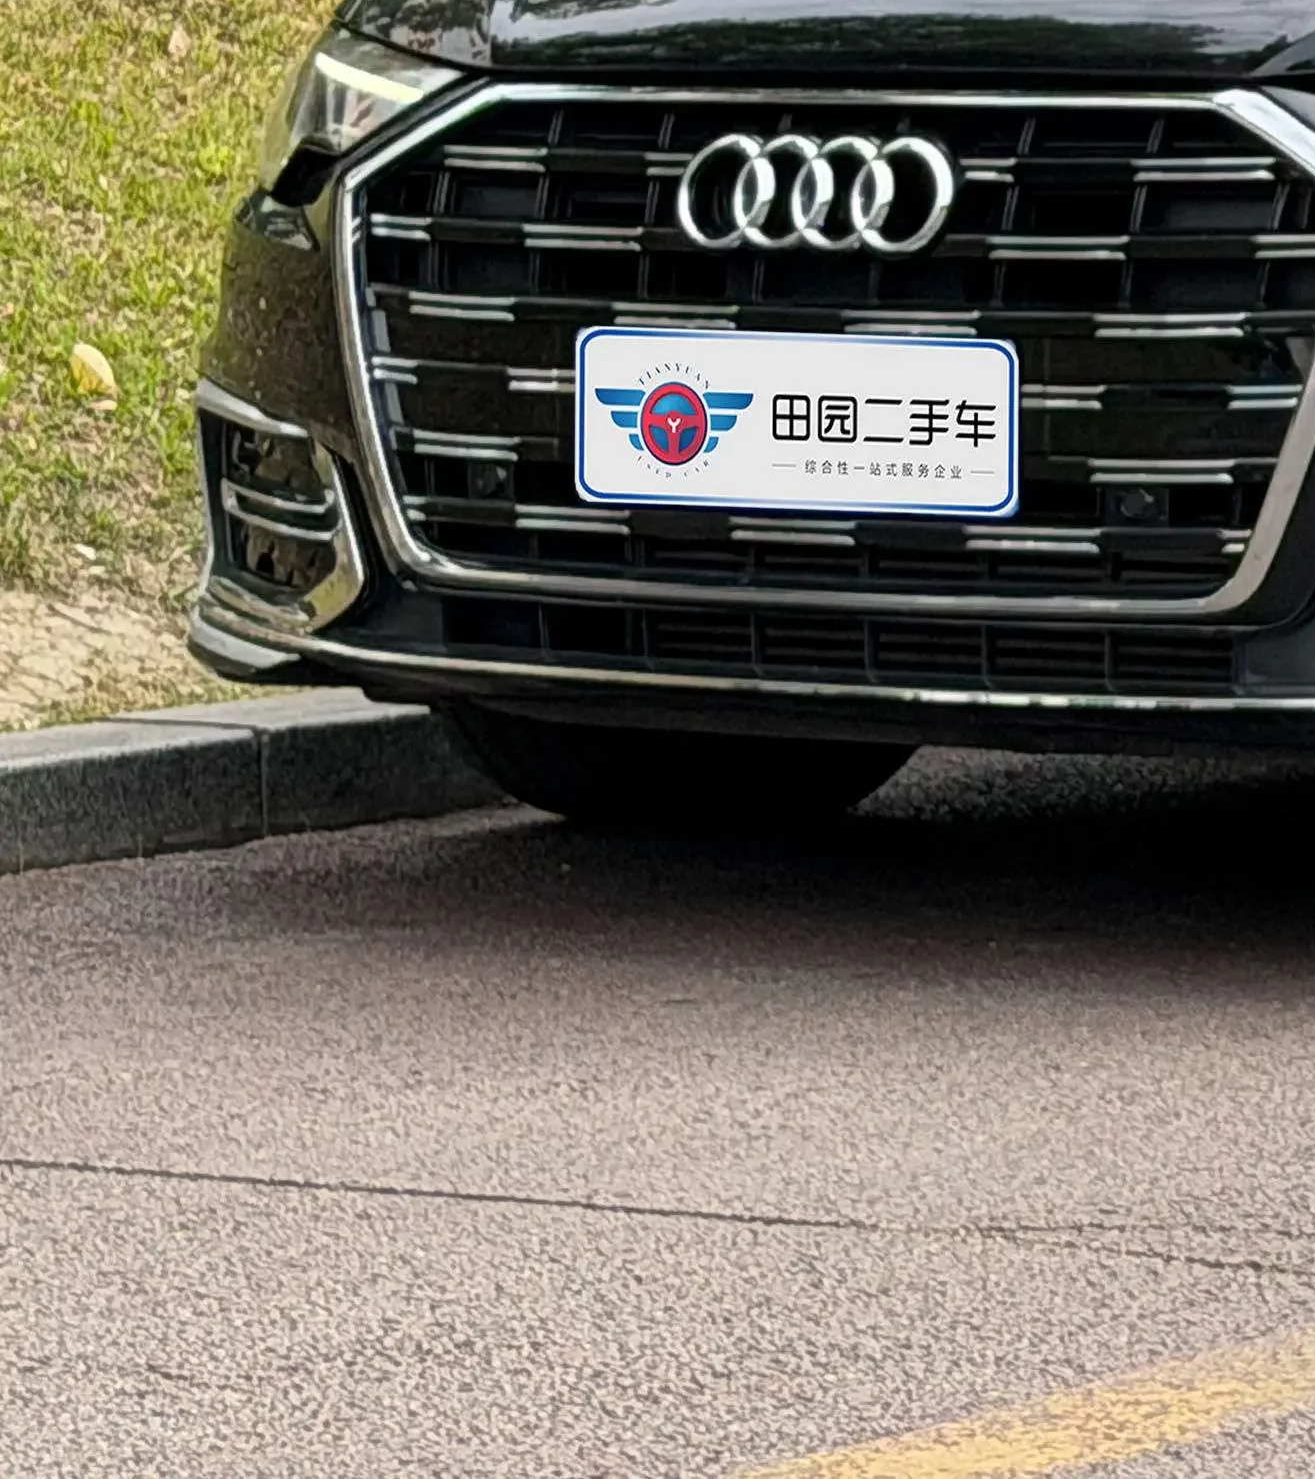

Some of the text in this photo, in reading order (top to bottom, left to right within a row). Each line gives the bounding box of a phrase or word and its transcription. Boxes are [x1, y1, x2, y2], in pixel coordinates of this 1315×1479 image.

[667, 417, 681, 433] Y
[772, 394, 997, 448] 田园二手车
[804, 459, 962, 479] 综合性一站式服务企业
